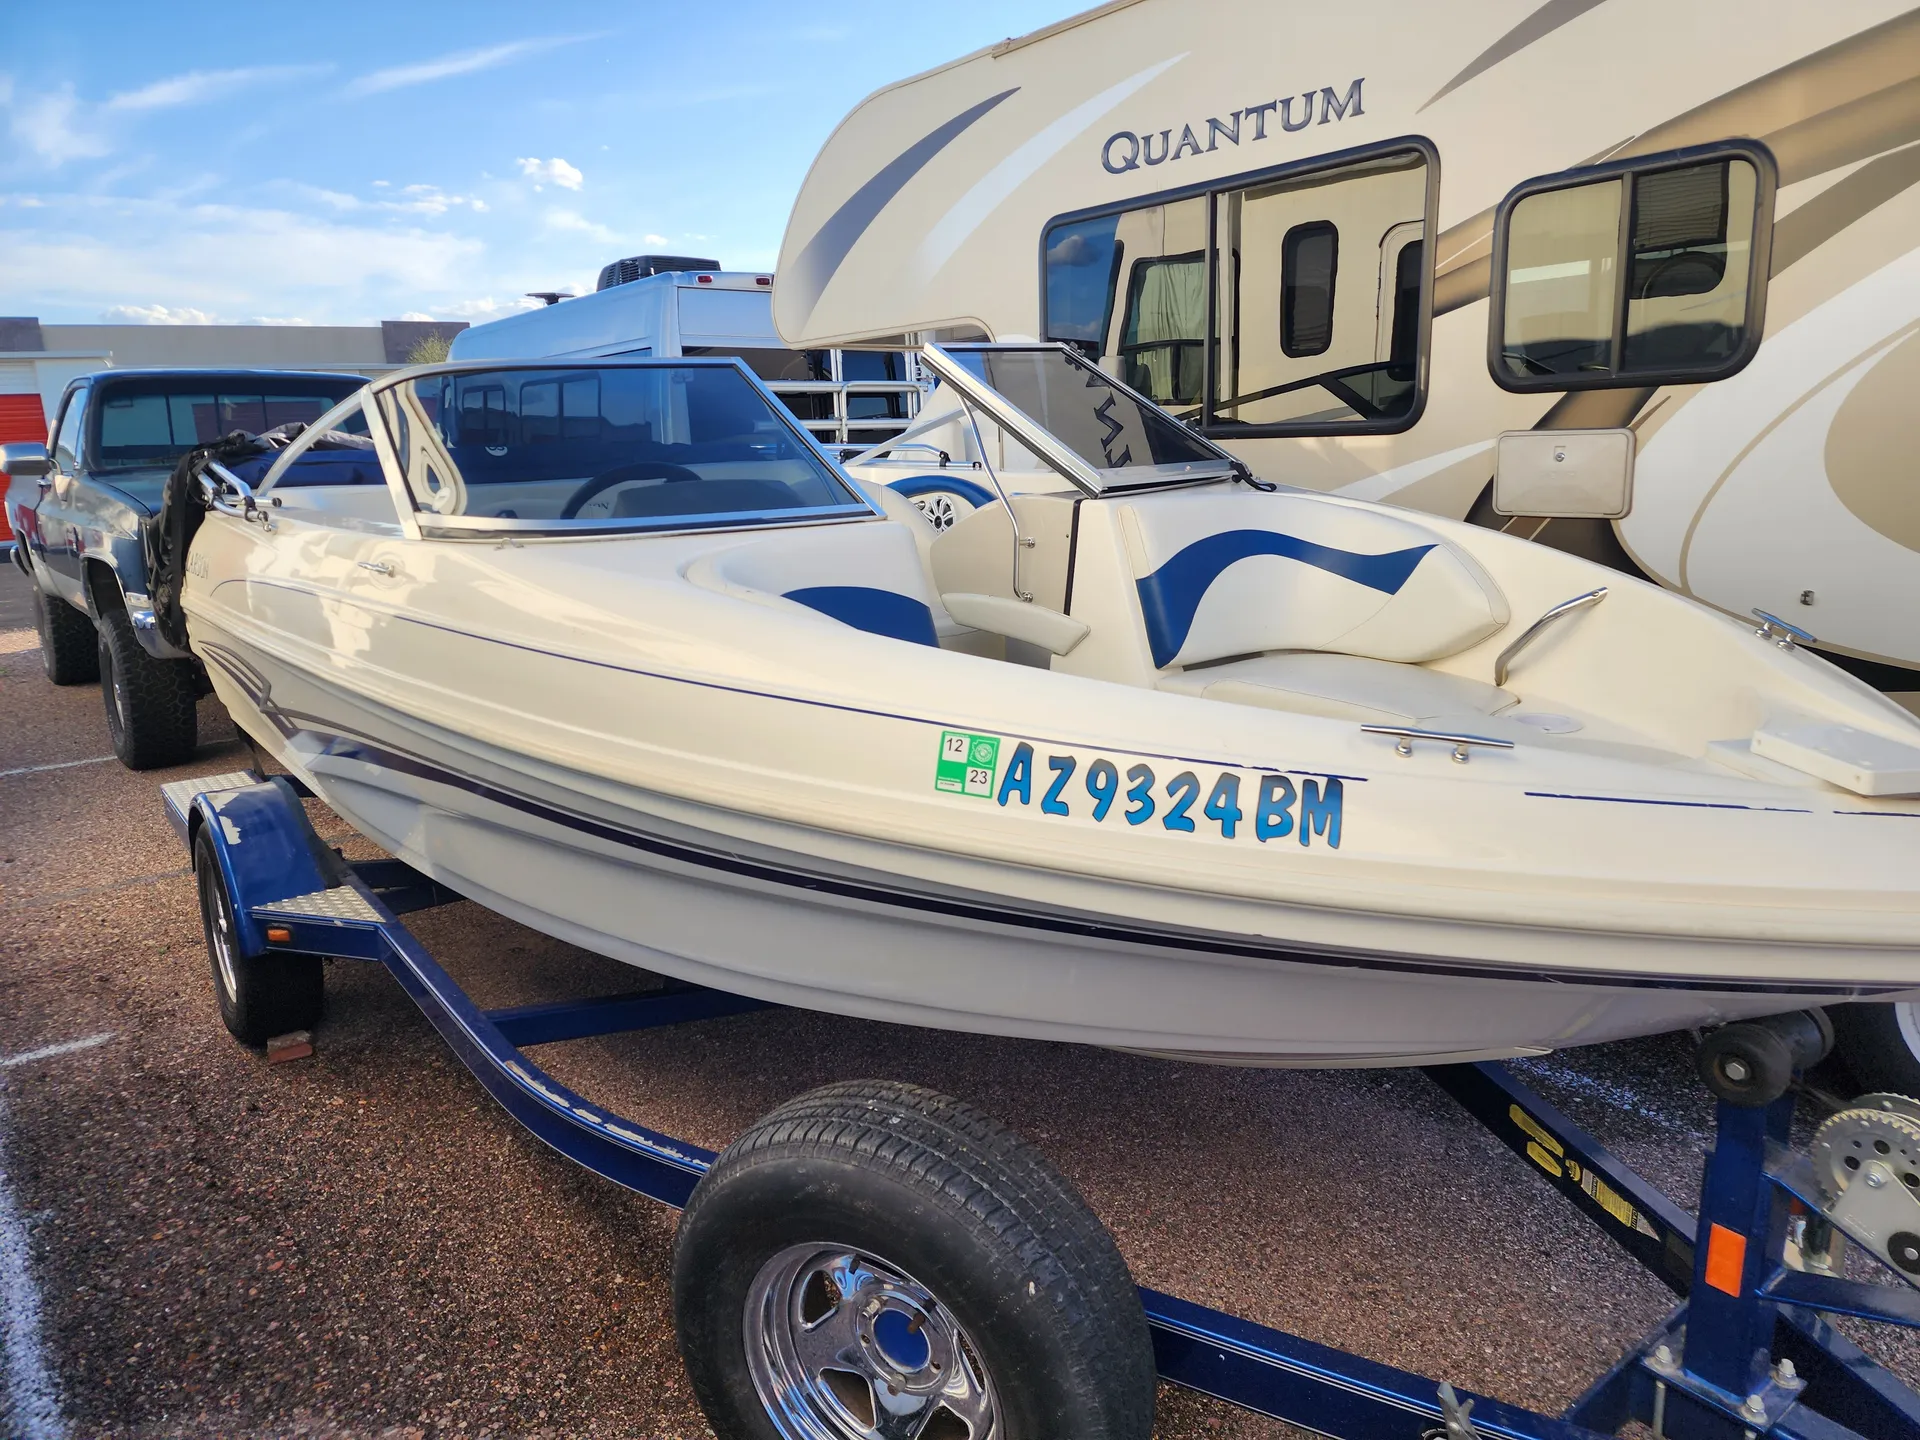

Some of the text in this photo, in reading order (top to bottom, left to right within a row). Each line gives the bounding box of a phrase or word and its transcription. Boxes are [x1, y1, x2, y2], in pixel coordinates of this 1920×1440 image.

[1101, 77, 1365, 174] QUANTUM
[946, 737, 964, 753] 12
[969, 769, 988, 785] 23
